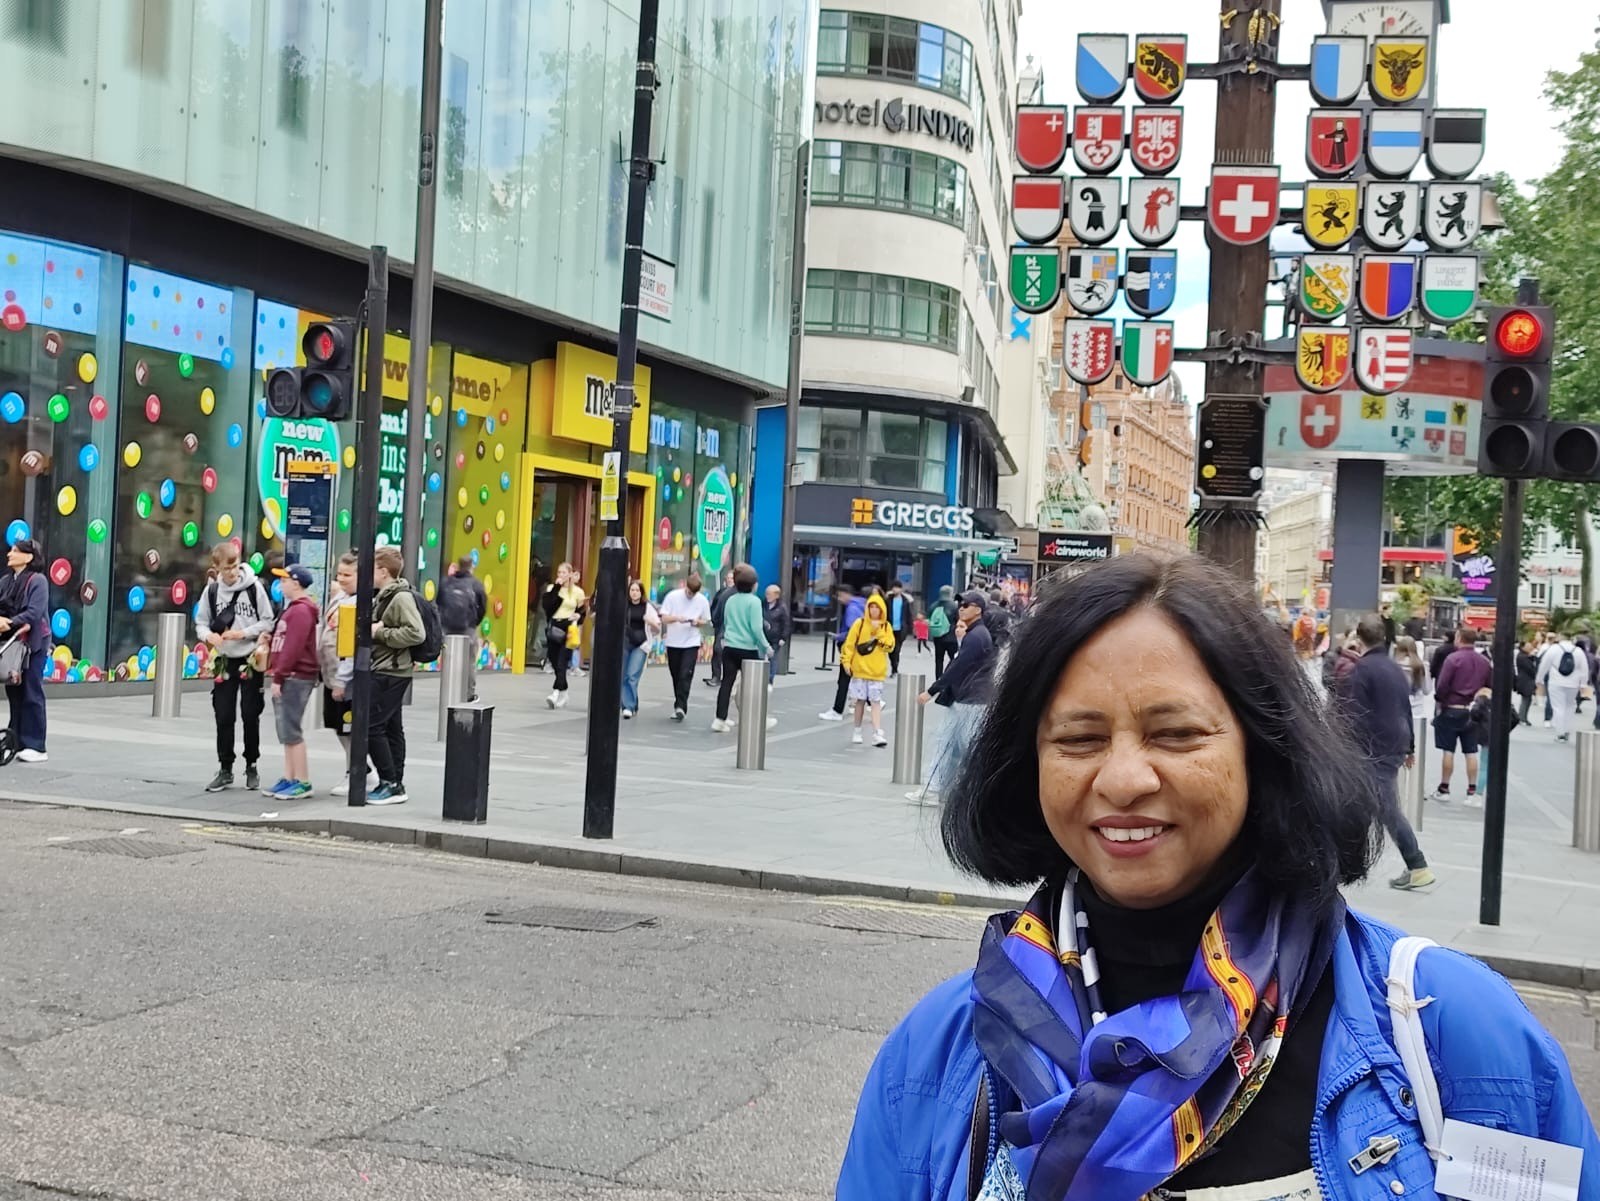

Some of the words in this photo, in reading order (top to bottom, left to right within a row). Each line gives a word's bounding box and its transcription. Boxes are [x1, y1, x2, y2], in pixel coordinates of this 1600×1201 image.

[908, 103, 974, 153] INDIGO
[281, 421, 325, 441] new
[380, 408, 433, 439] mii
[707, 492, 727, 504] new
[877, 500, 975, 531] GREGGS
[1055, 545, 1108, 558] cineworld
